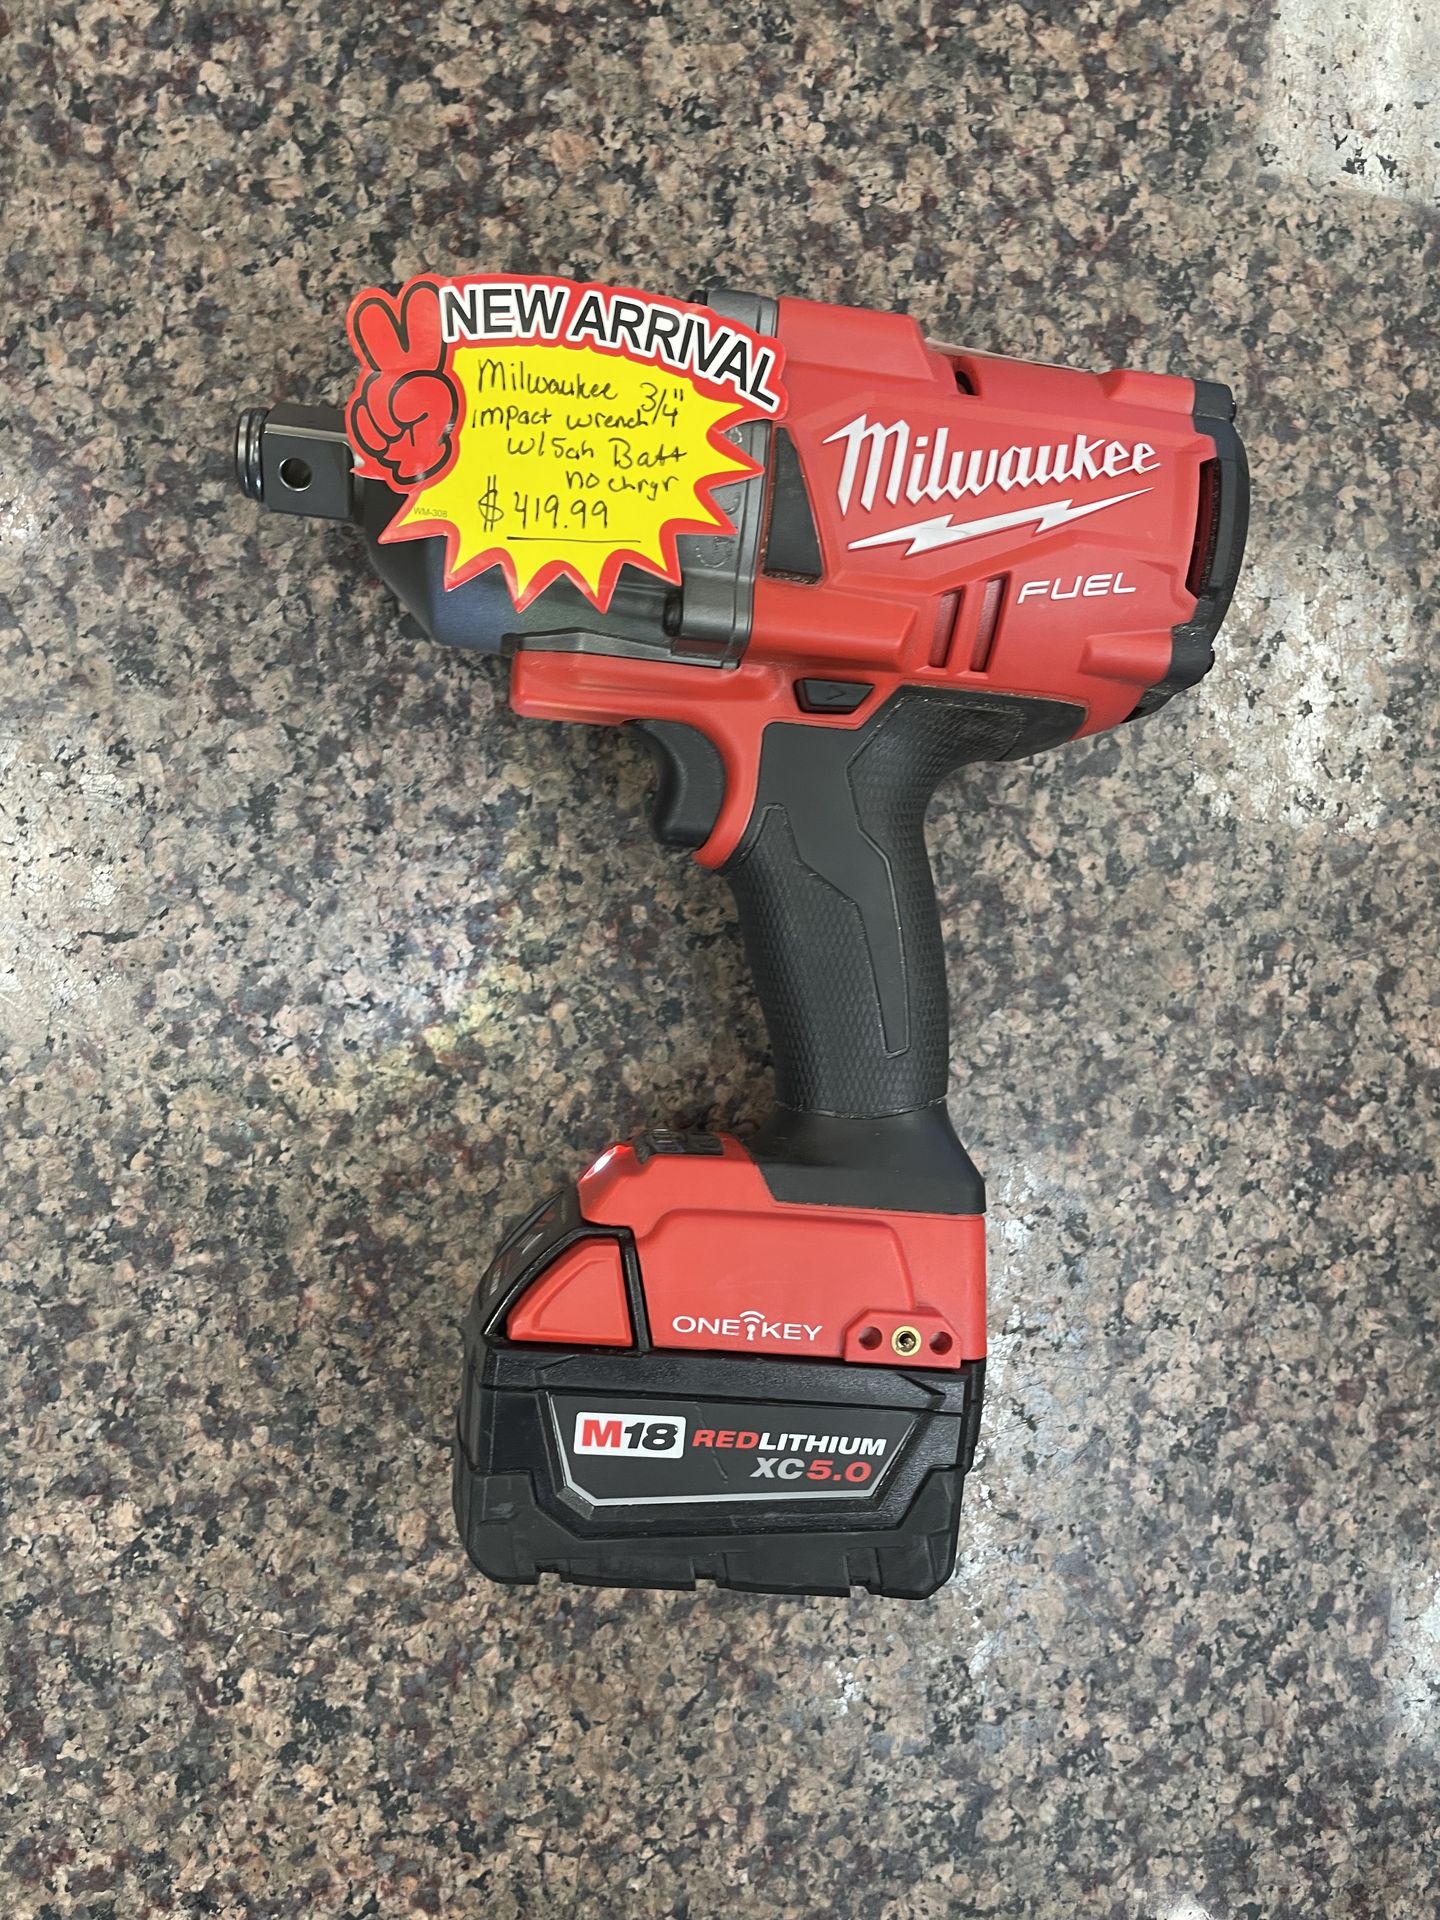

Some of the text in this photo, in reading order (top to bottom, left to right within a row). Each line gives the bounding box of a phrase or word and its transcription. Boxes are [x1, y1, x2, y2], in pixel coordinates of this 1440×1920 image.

[444, 287, 776, 408] NEW ARRIVAL
[478, 358, 618, 400] Milwaukee
[566, 409, 648, 430] wrench
[608, 437, 687, 469] Batt
[822, 414, 1161, 516] Milwaukee
[566, 470, 600, 490] no
[1017, 572, 1136, 604] FUEL
[581, 1418, 887, 1456] M18 REDLITHIUM
